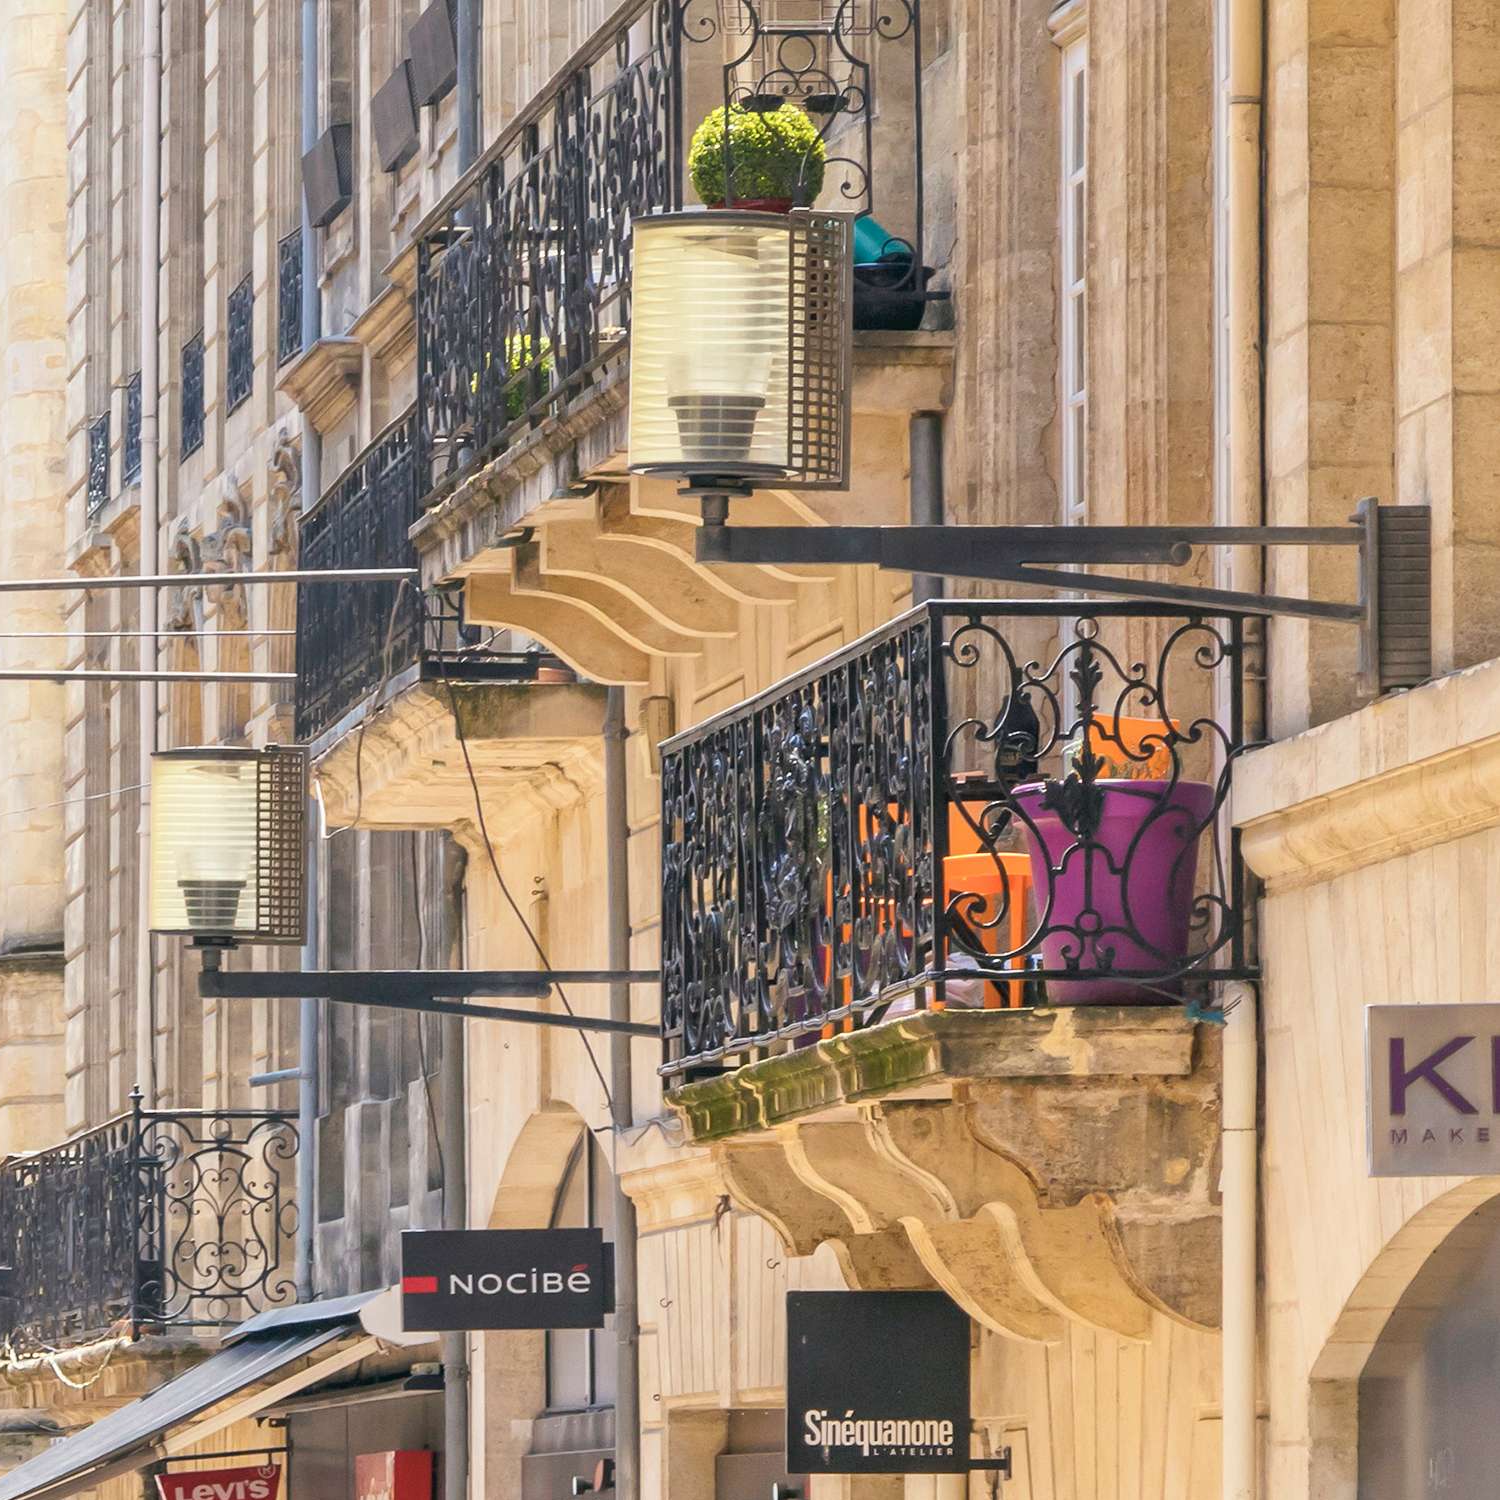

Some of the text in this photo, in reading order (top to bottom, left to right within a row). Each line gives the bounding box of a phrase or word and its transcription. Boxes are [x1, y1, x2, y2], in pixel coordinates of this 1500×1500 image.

[1390, 1127, 1490, 1145] MAKE
[804, 1409, 954, 1457] Sinéquanone
[873, 1448, 954, 1456] L'ATELIER
